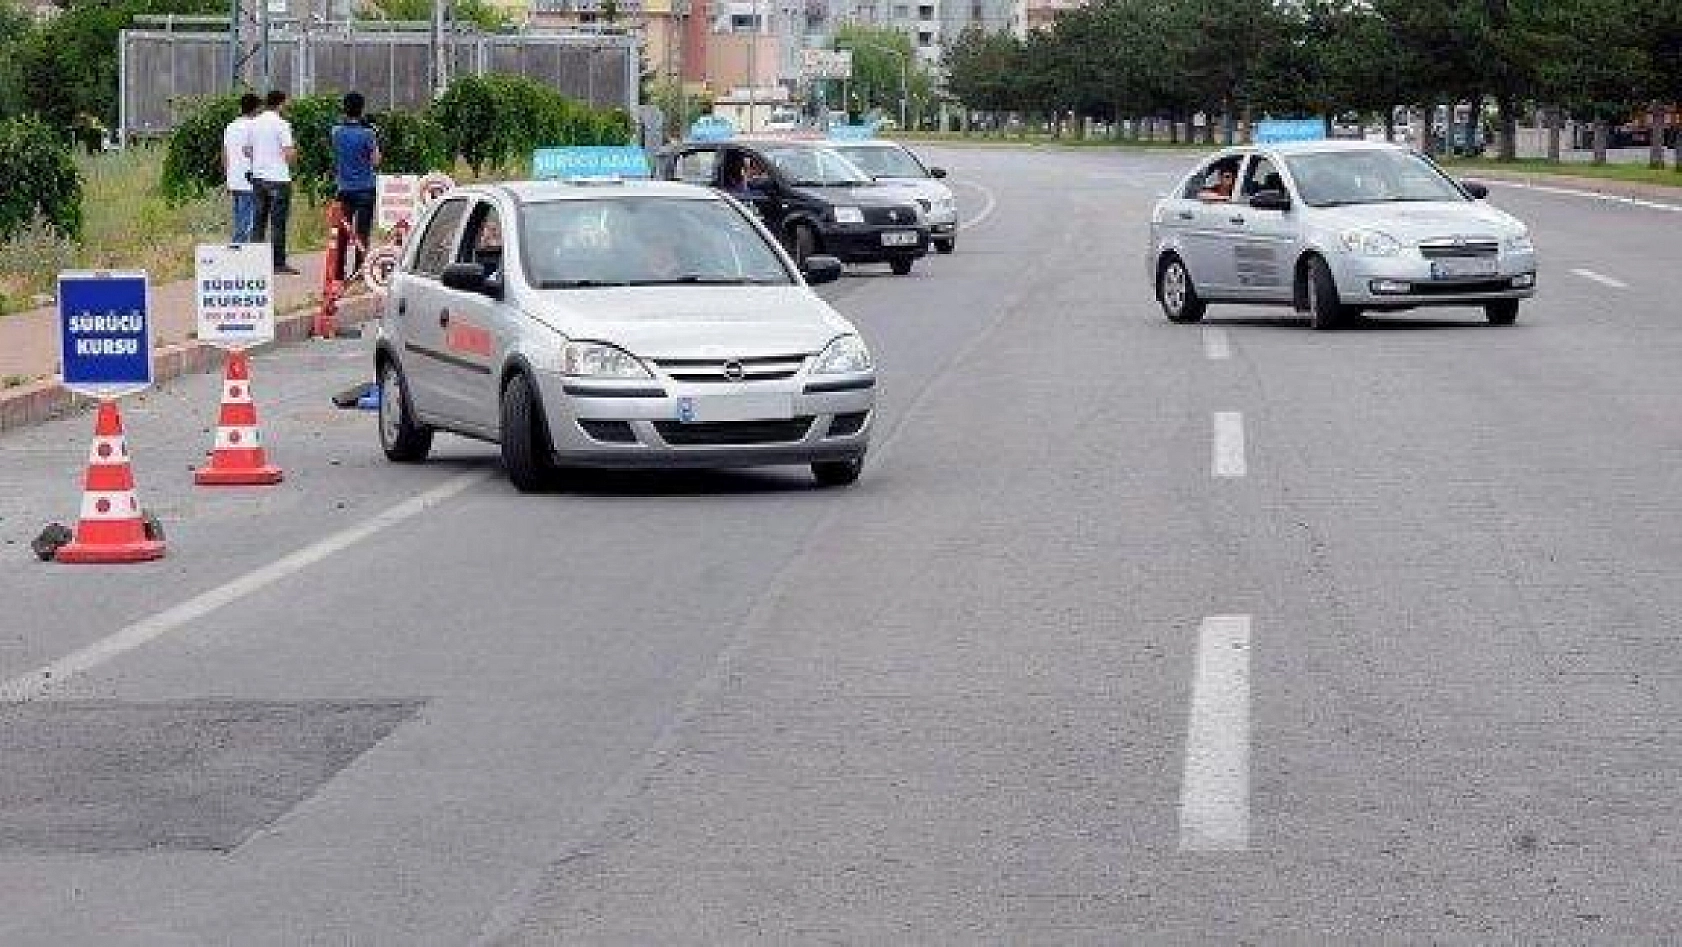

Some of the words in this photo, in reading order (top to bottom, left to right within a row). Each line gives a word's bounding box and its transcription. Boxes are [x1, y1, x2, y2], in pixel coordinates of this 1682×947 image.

[203, 274, 266, 291] SÜRÜCÜ
[203, 293, 268, 308] KURSU
[69, 309, 143, 332] SÜRÜCÜ
[77, 338, 138, 355] KURSU
